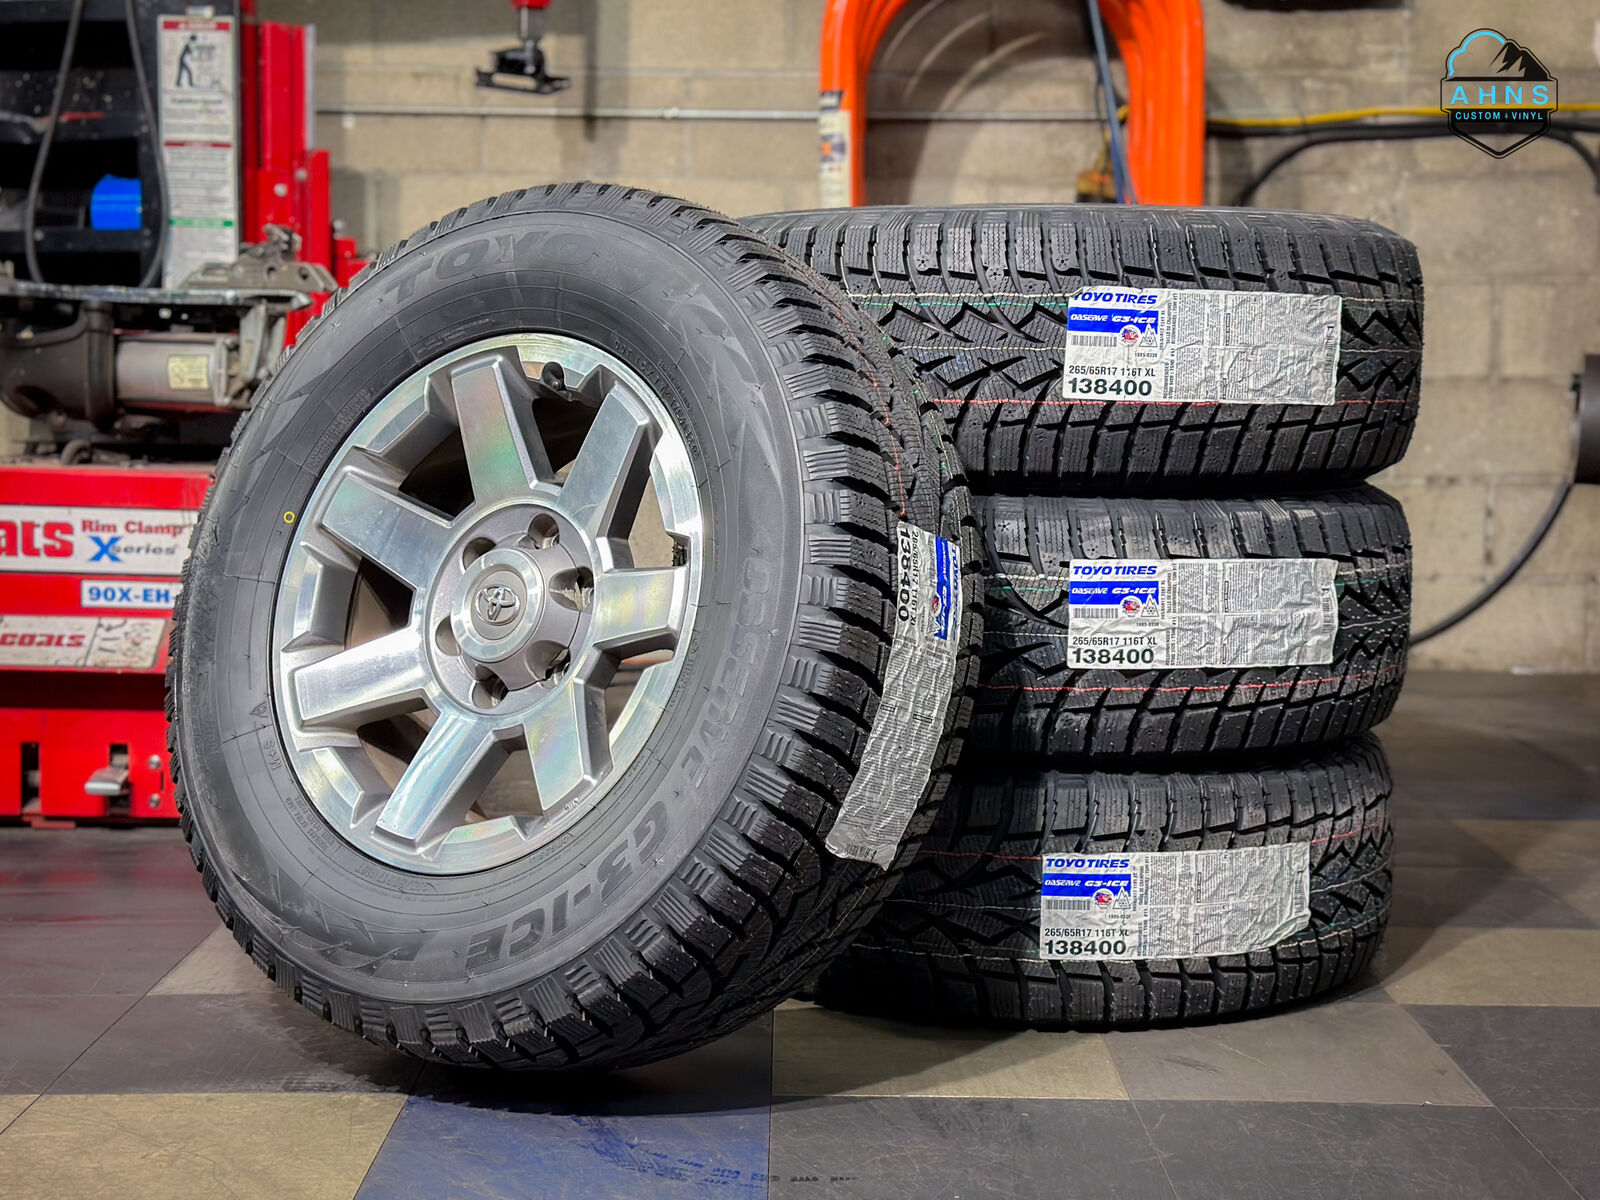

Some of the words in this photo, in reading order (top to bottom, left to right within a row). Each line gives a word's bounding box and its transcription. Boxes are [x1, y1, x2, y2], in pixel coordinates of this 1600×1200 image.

[385, 231, 600, 303] TOYO
[1115, 294, 1158, 304] TIRES
[1112, 316, 1156, 324] G3-ICE
[1068, 366, 1118, 375] 265/65R17
[1120, 368, 1144, 376] 116T
[1145, 368, 1156, 376] XL
[1068, 378, 1152, 396] 138400
[82, 520, 117, 532] Rim
[125, 520, 183, 538] Clamp
[898, 528, 911, 622] 138400
[1073, 566, 1112, 575] TOYO
[1114, 566, 1157, 575] TIRES
[1073, 637, 1119, 646] 265/65R17
[1124, 637, 1145, 645] 116T
[1147, 637, 1158, 645] XL
[1072, 648, 1154, 664] 138400
[264, 738, 282, 770] M+S
[1046, 859, 1085, 867] TOYO
[1088, 859, 1130, 868] TIRES
[464, 800, 672, 975] G3-ICE
[1045, 928, 1092, 937] 265/65R17
[1045, 940, 1126, 955] 138400
